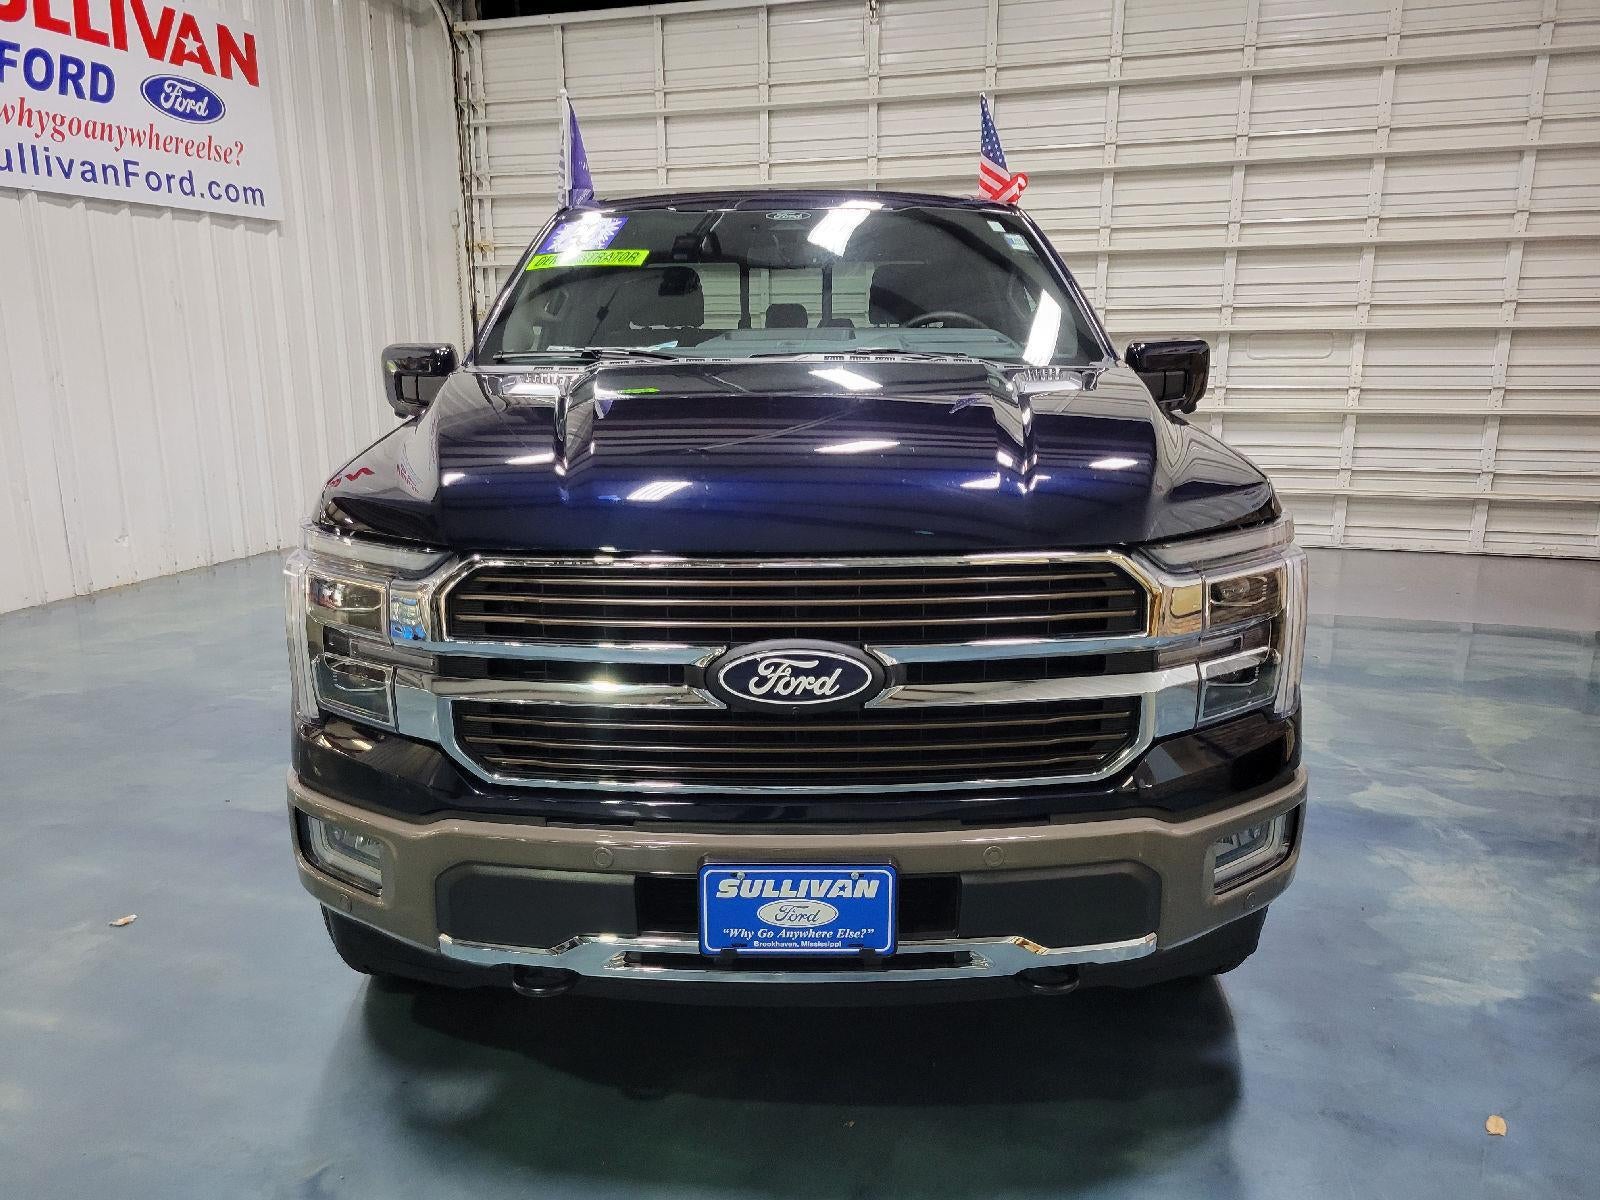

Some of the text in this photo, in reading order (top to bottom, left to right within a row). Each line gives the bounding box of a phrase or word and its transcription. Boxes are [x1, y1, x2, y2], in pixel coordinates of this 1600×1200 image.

[0, 0, 259, 87] LLIVAN
[0, 40, 116, 104] FORD
[160, 79, 209, 117] Ford
[534, 251, 640, 267] DESTRATOR
[748, 657, 843, 696] Ford
[715, 878, 880, 898] SULLIVAN
[774, 904, 820, 923] Ford
[723, 928, 875, 940] “Why Go Anywhere Else?”
[801, 940, 842, 949] Mississippi
